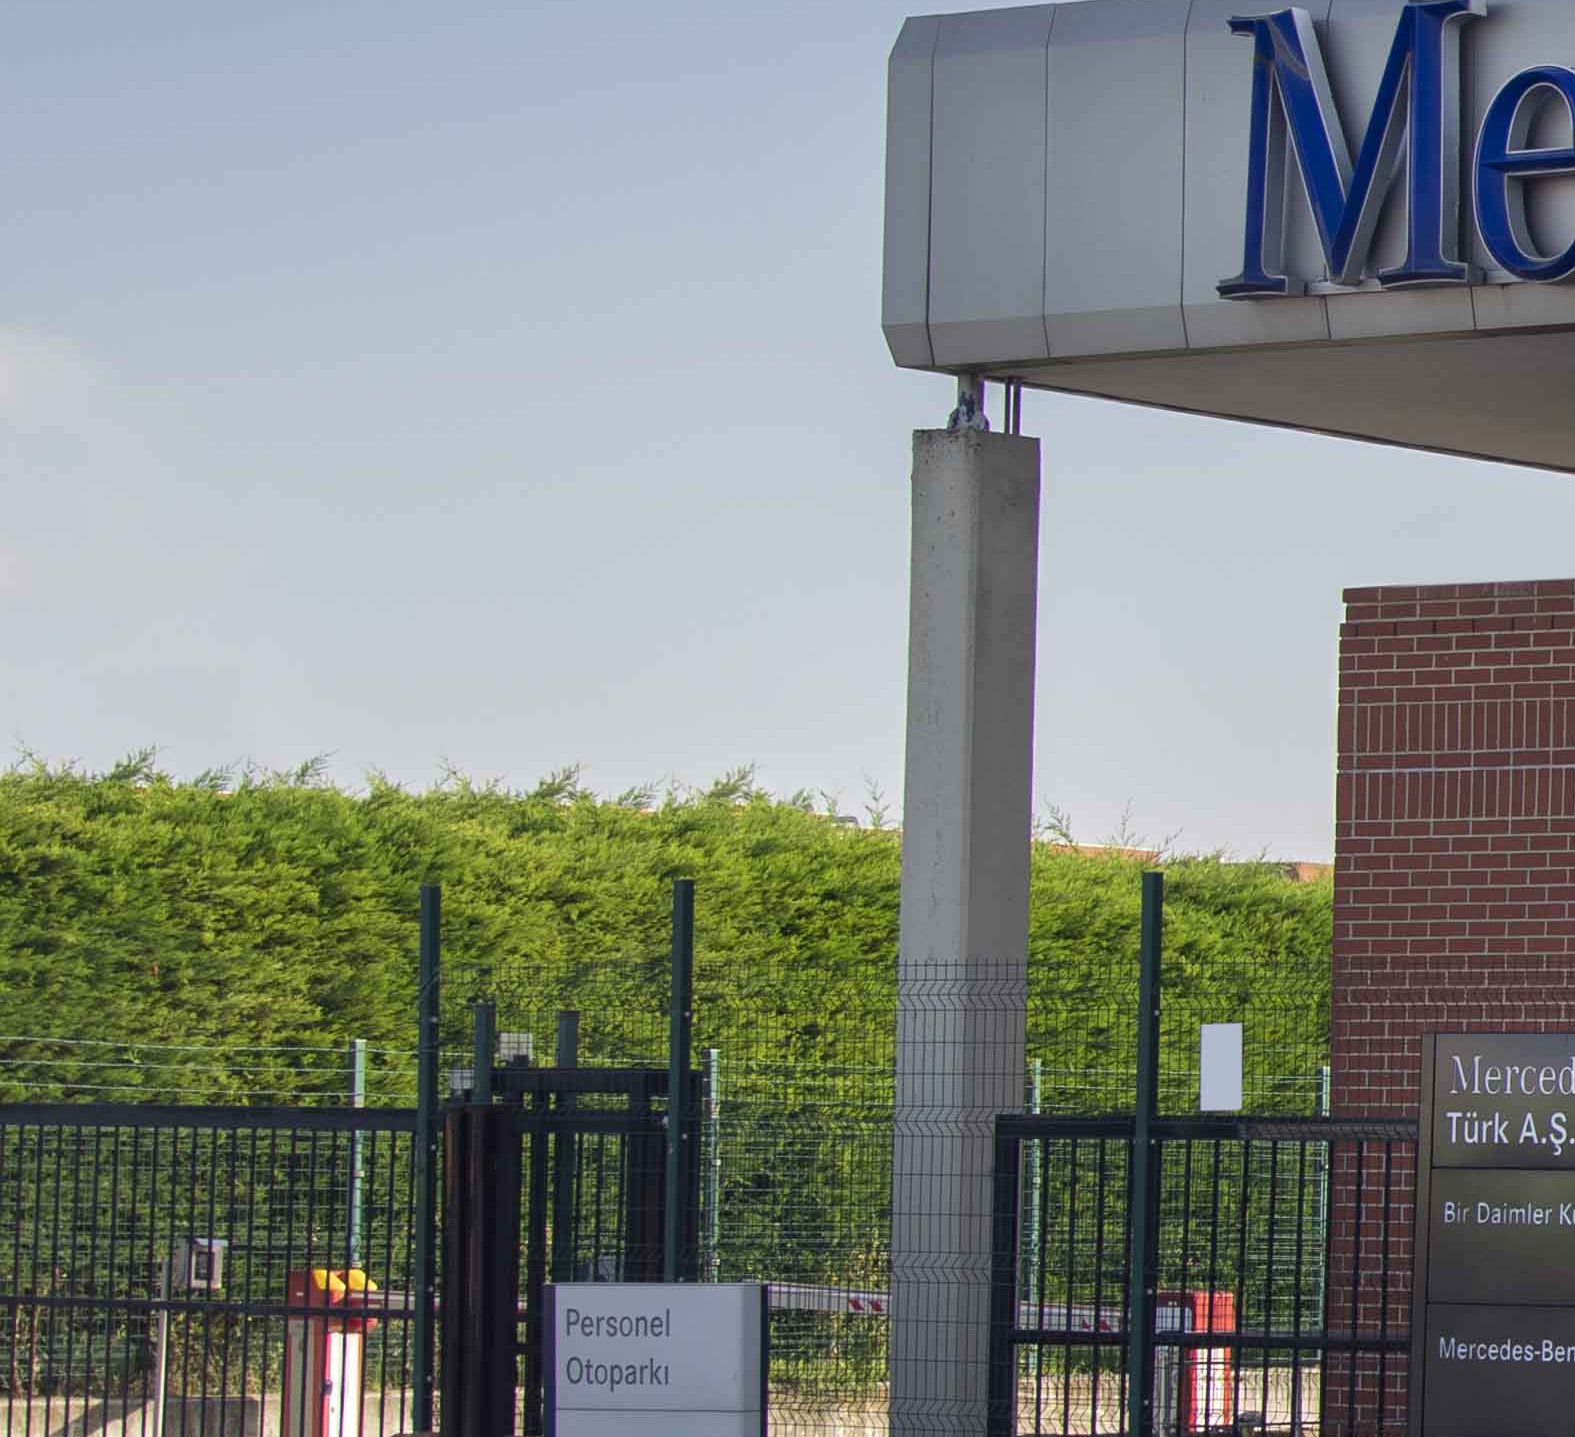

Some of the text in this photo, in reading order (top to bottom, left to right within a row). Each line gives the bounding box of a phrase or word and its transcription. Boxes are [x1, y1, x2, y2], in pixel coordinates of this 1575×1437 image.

[1446, 1111, 1575, 1156] Türk A.Ş.
[1444, 1202, 1470, 1225] Bir
[1477, 1202, 1552, 1226] Daimler
[566, 1308, 670, 1337] Personel
[566, 1357, 669, 1392] Otoparkı
